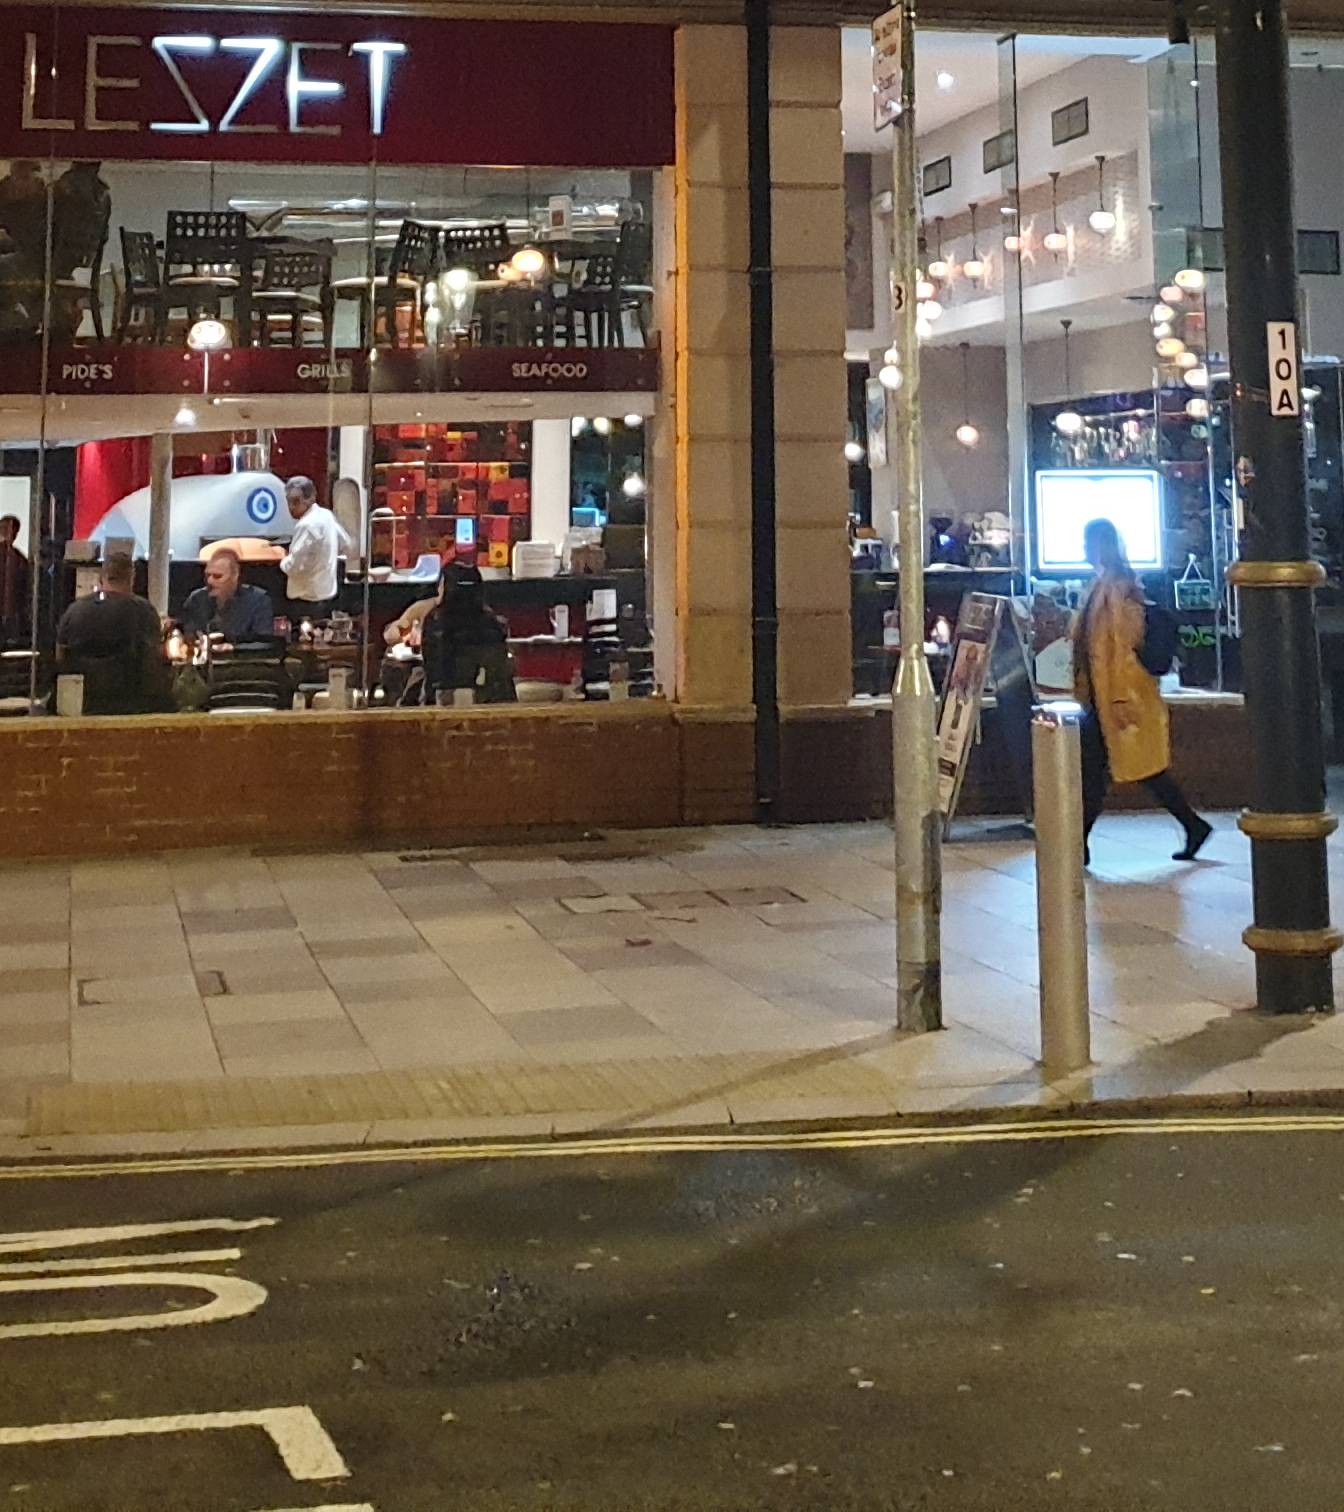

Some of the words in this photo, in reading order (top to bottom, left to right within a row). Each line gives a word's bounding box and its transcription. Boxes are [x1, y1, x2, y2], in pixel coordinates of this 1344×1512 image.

[62, 363, 113, 380] PIDE'S
[297, 363, 351, 378] GRILLS
[510, 362, 588, 378] SEAFOOD
